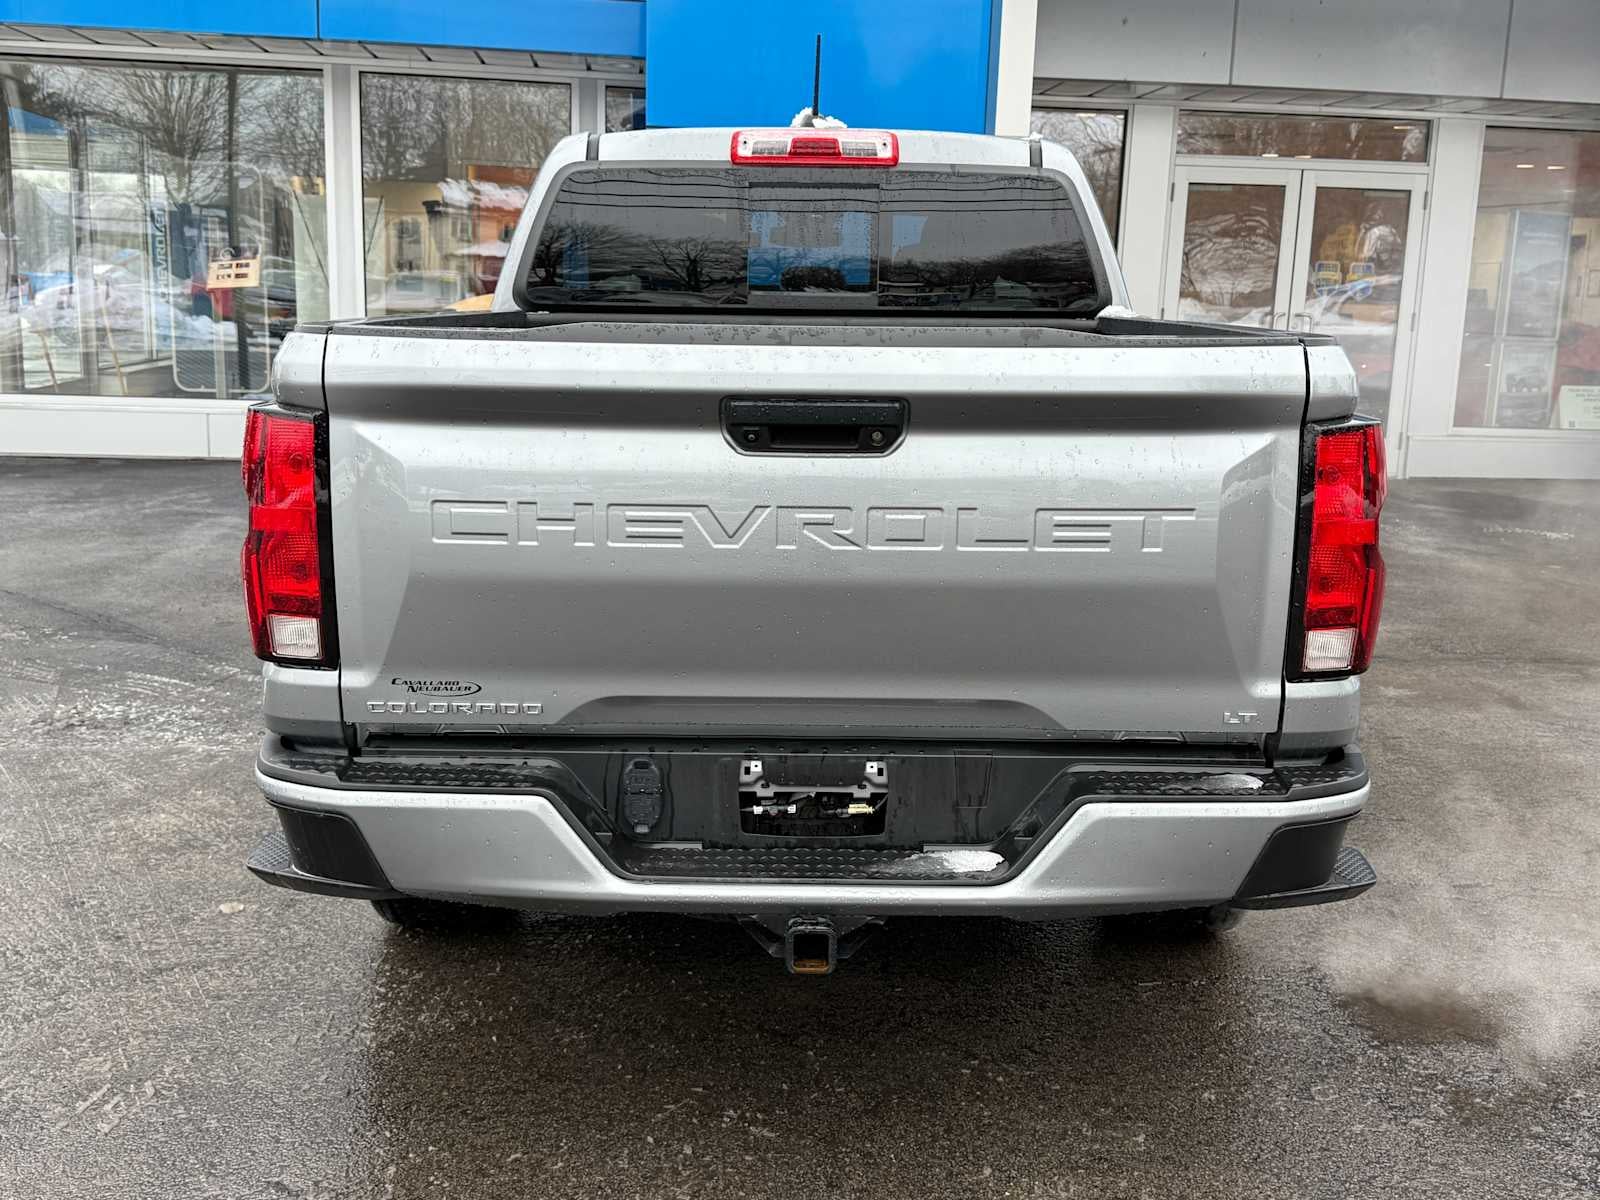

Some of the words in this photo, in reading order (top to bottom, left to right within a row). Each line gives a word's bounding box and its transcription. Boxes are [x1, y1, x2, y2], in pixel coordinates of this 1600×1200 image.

[431, 499, 1197, 553] CHEVROLET
[366, 701, 544, 715] COLORADO
[1223, 712, 1258, 725] LT
